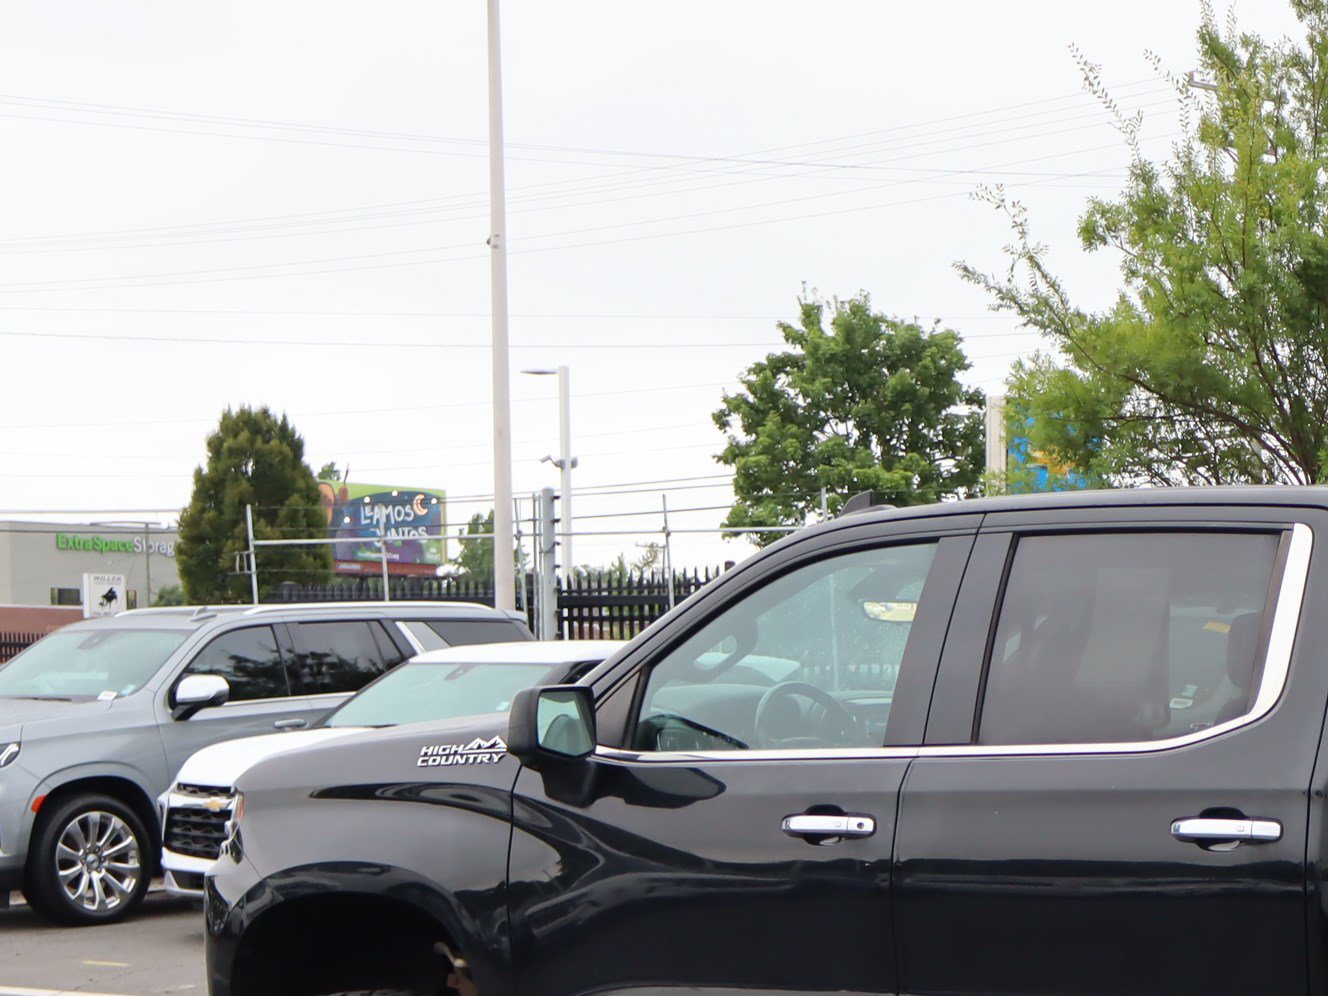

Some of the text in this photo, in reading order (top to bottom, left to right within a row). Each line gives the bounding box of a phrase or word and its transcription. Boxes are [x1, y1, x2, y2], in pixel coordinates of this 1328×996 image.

[361, 503, 415, 525] LEAMOS
[420, 744, 465, 756] HIGH
[416, 753, 506, 767] COUNTRY
